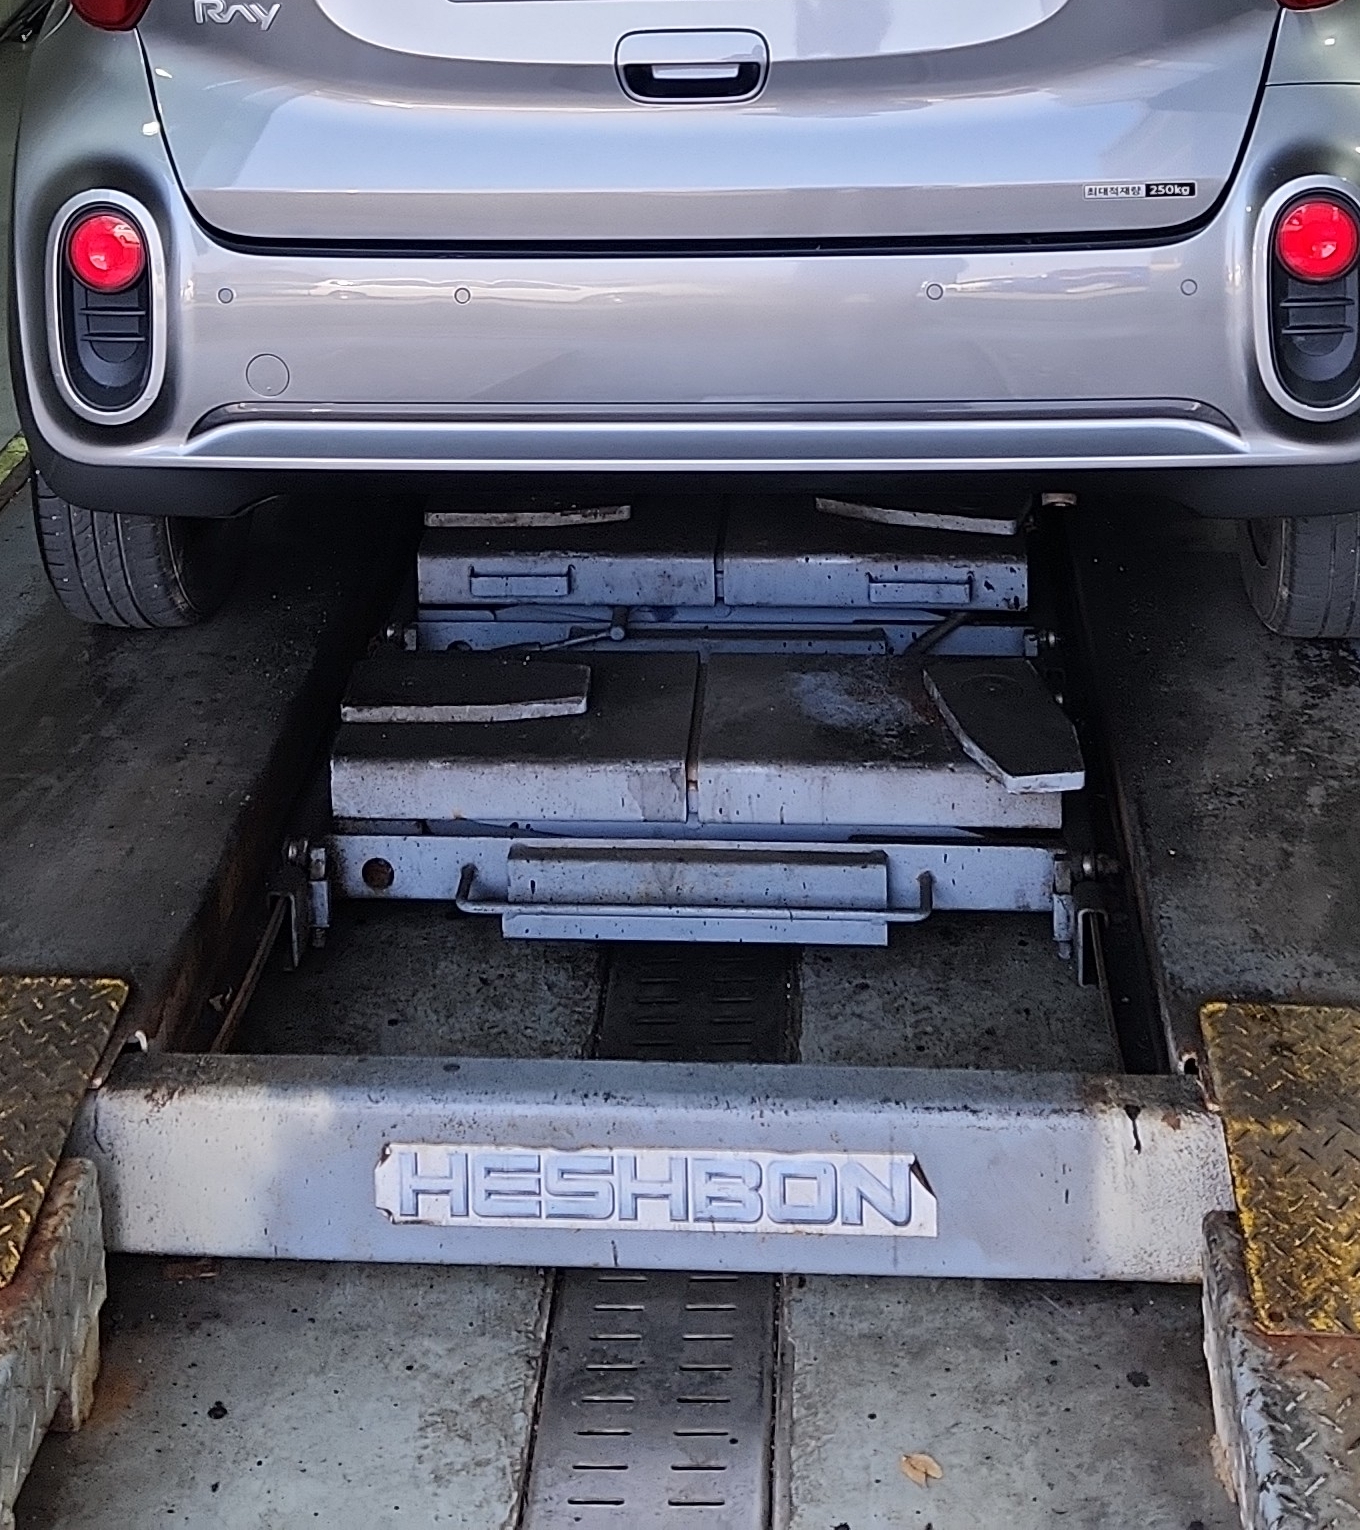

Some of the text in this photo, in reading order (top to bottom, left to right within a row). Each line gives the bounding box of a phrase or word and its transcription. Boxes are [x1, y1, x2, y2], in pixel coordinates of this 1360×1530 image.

[1087, 184, 1190, 197] 최대적재량 250kg
[398, 1151, 915, 1227] HESHBON
